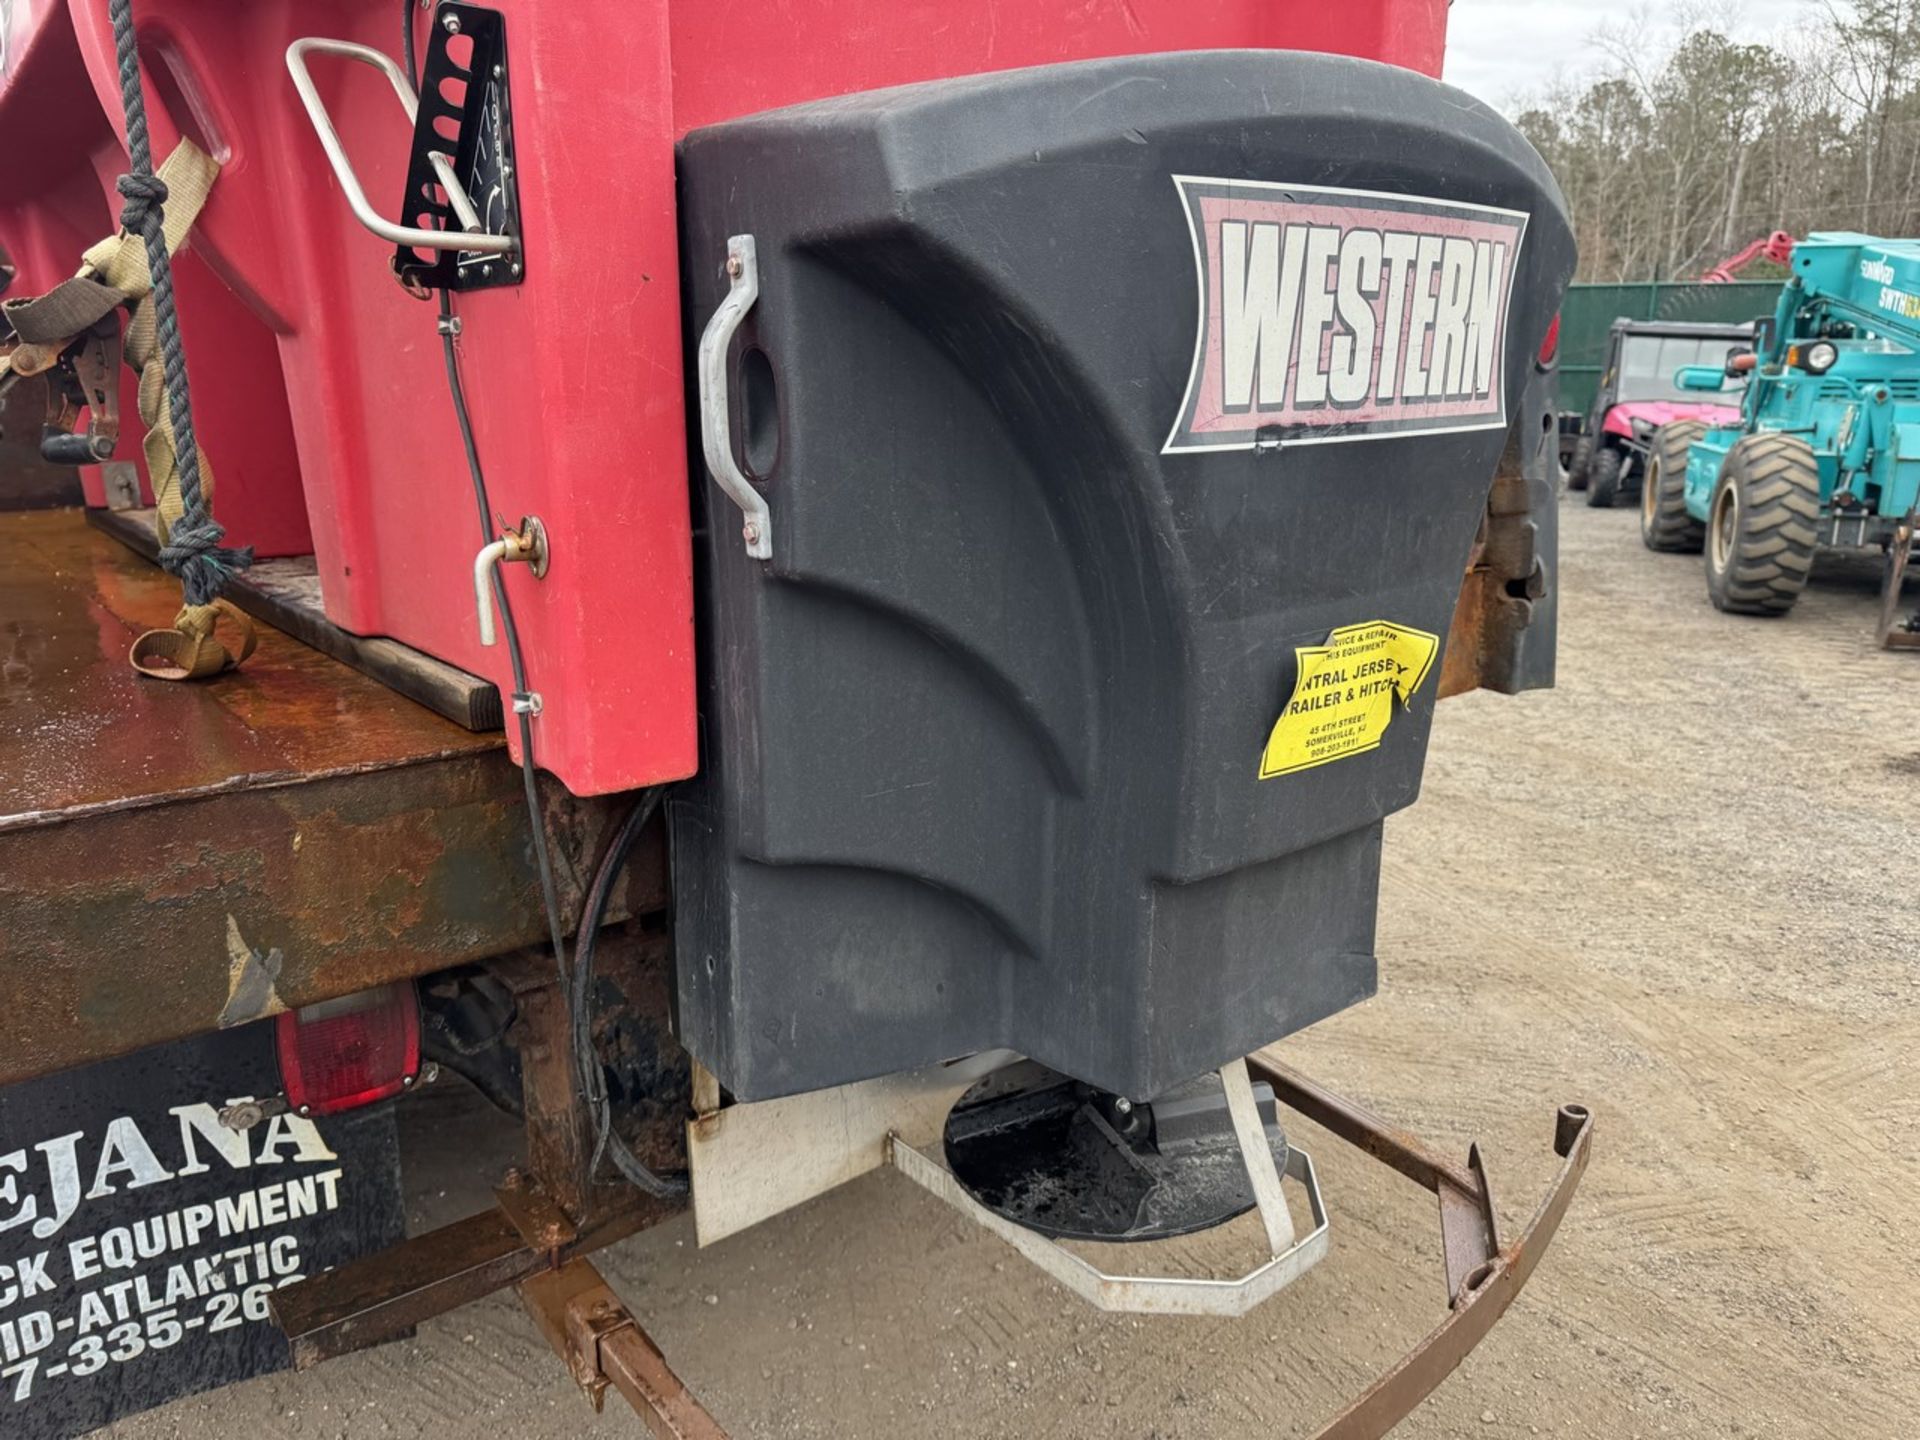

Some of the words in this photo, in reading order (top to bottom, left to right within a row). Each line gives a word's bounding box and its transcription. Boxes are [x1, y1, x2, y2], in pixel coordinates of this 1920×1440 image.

[1220, 219, 1506, 413] WESTERN
[1357, 633, 1365, 643] &
[1342, 641, 1386, 658] EQUIPMENT
[1352, 657, 1408, 679] JERSEY
[1345, 686, 1355, 703] &
[1321, 721, 1337, 733] 4TH
[1338, 713, 1366, 728] STREET
[69, 1168, 343, 1281] EQUIPMENT
[0, 1235, 300, 1363] ID-ATLANTIC
